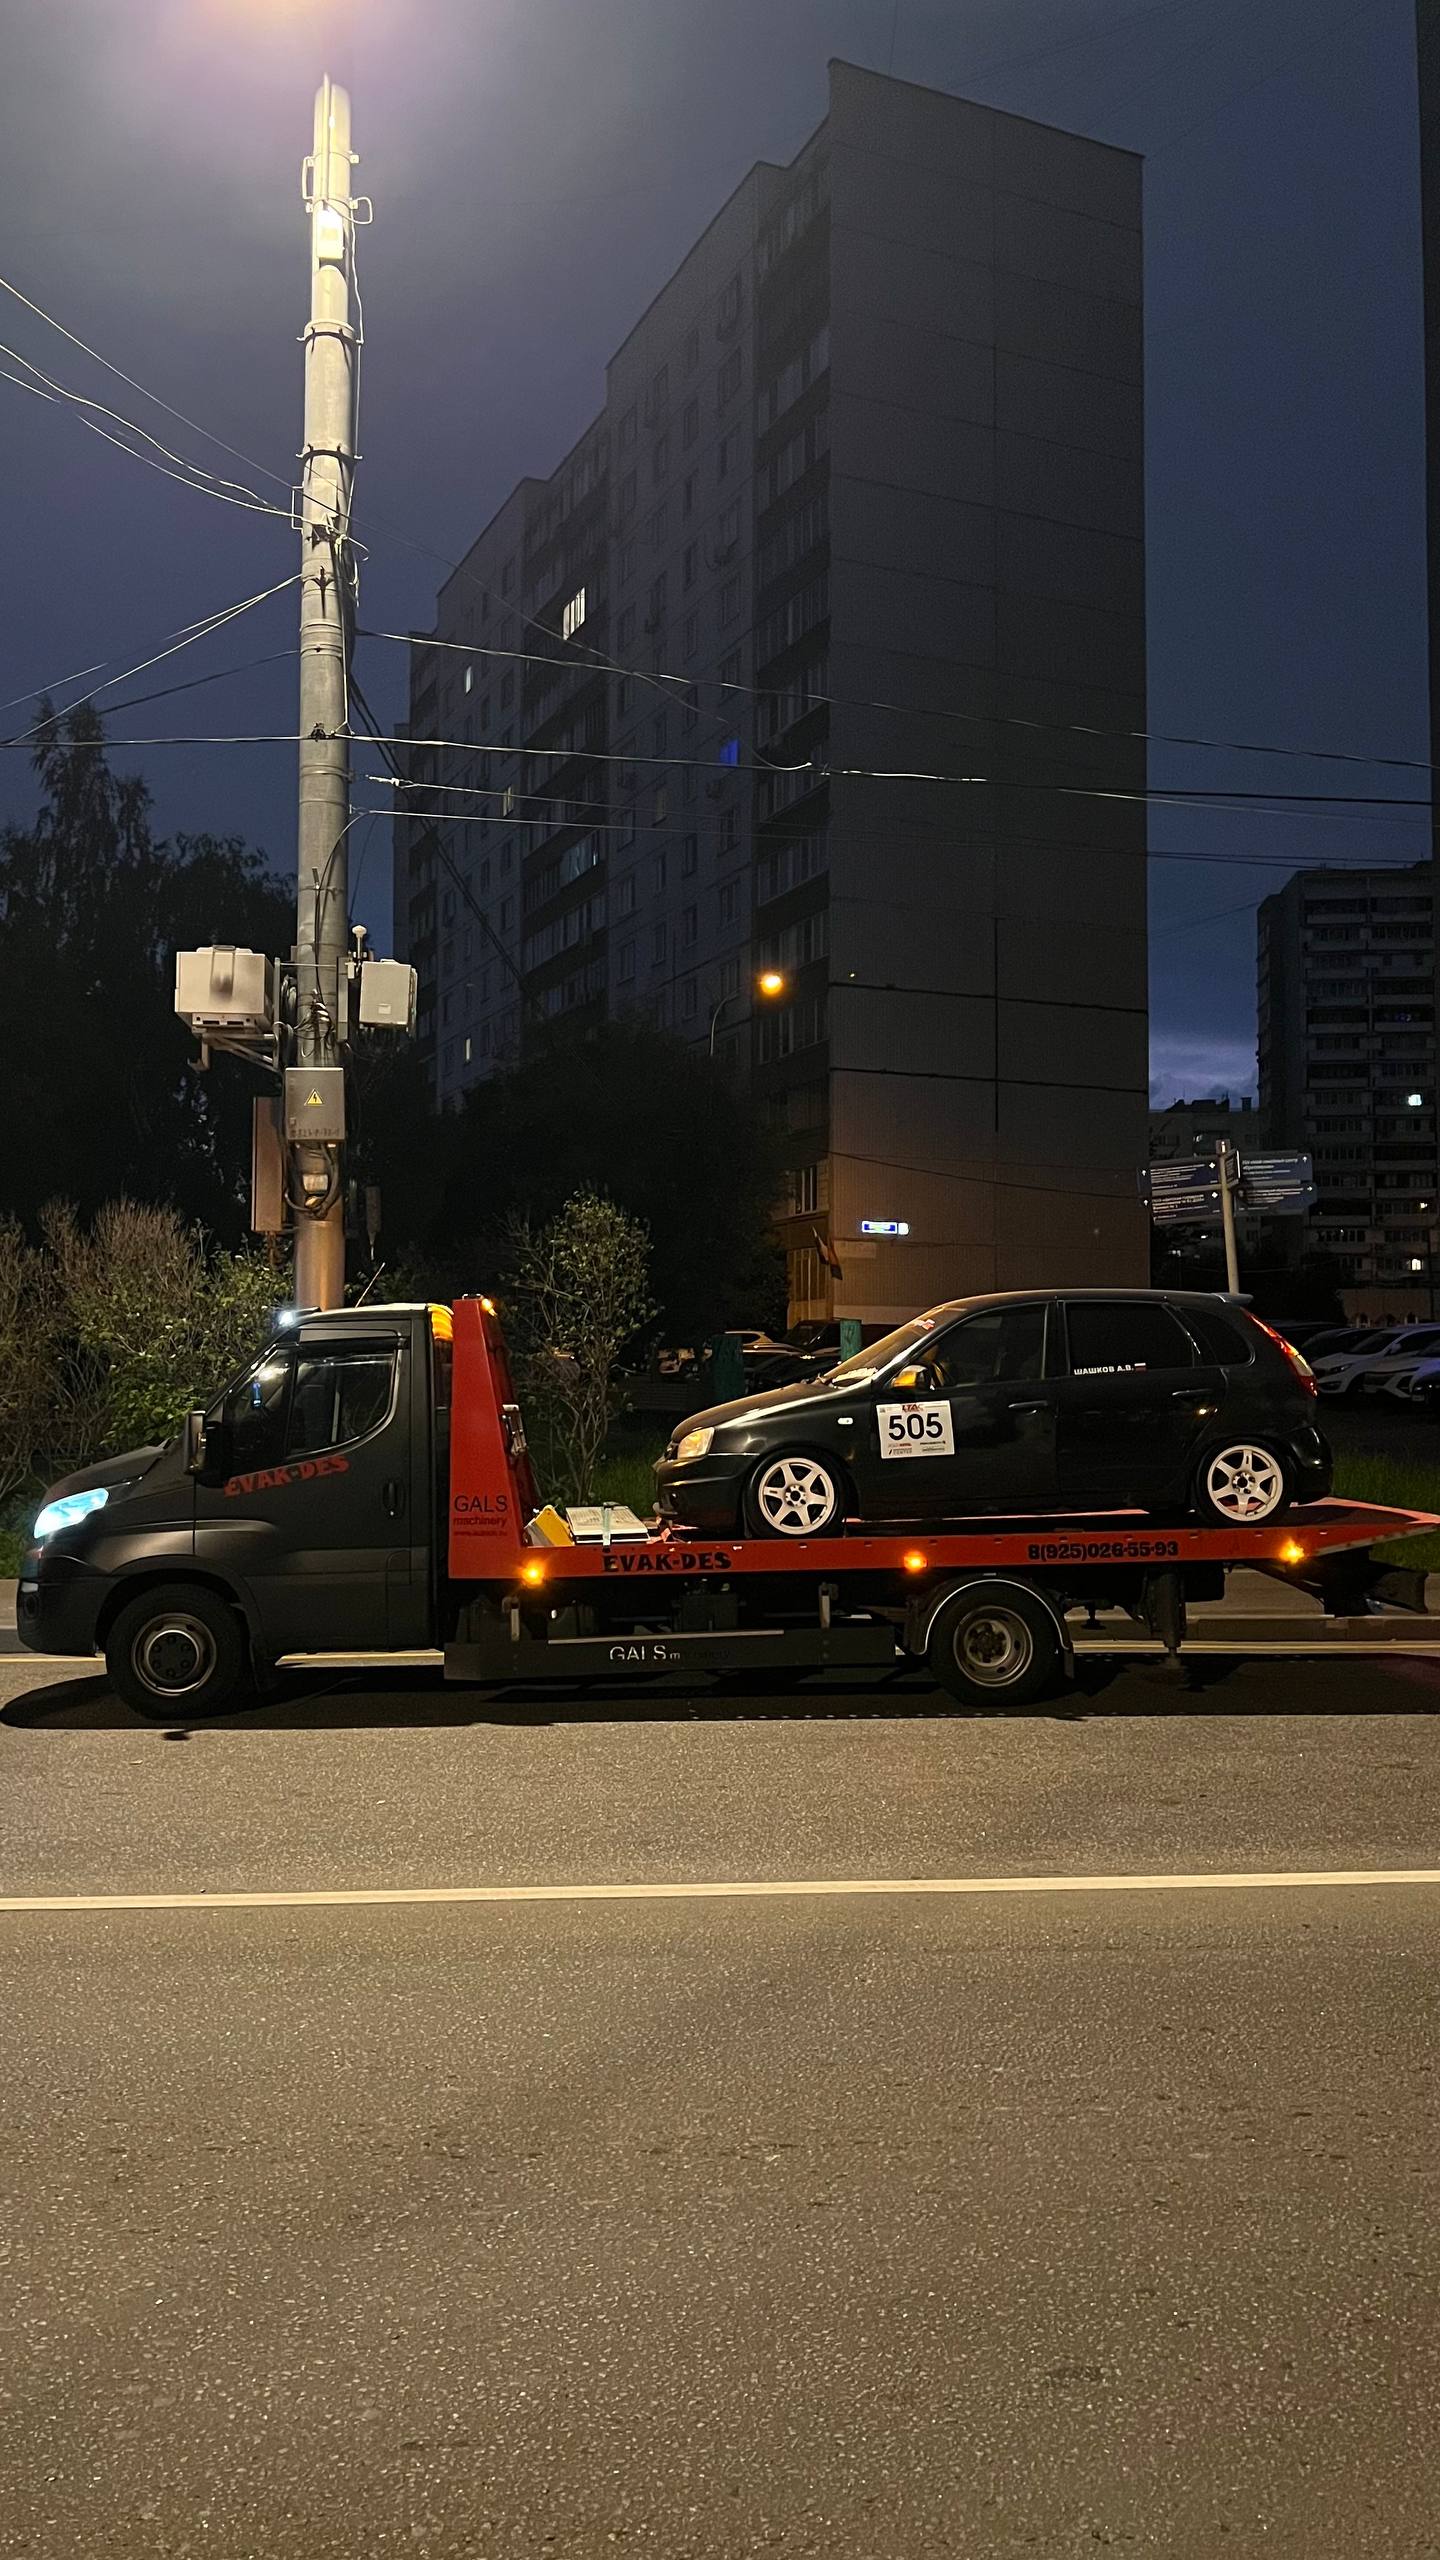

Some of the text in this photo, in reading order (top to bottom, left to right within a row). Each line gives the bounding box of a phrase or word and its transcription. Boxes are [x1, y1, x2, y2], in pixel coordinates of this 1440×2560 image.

[1073, 1365, 1115, 1376] ШАШКОВ
[888, 1412, 943, 1441] 505
[224, 1456, 350, 1497] EVAK-DES
[454, 1495, 508, 1513] GALS
[603, 1552, 732, 1573] EVAK-DES
